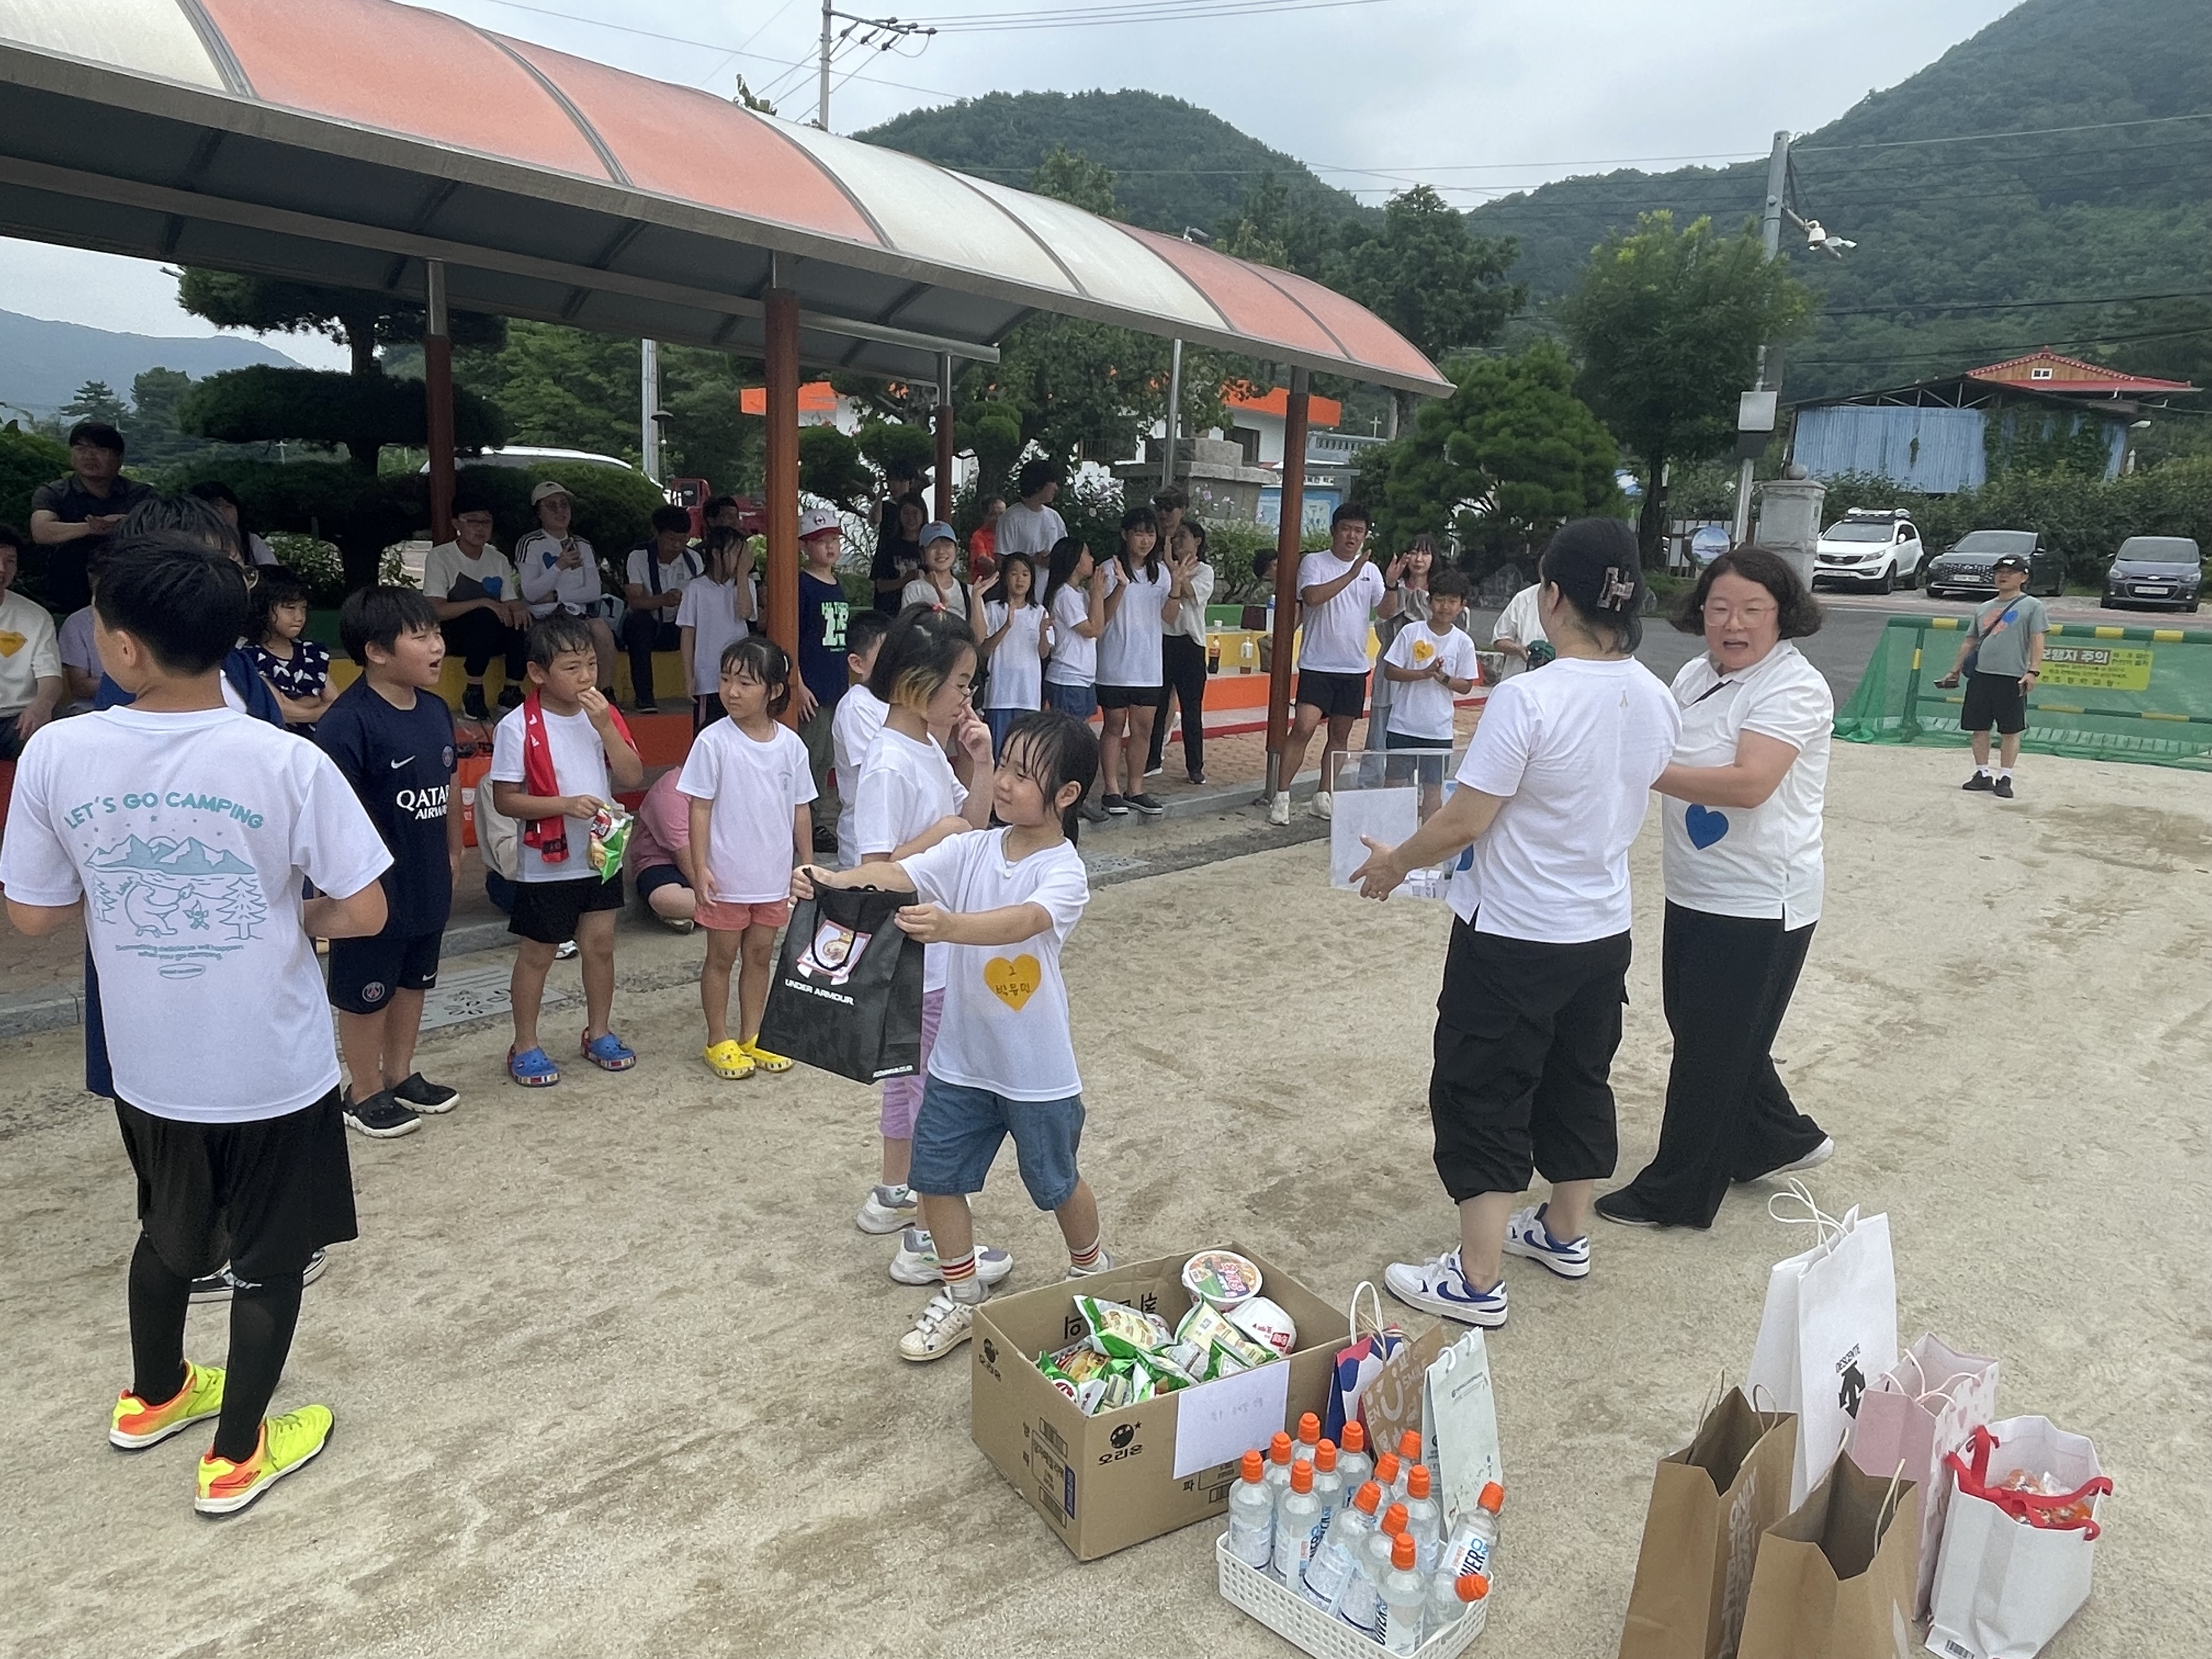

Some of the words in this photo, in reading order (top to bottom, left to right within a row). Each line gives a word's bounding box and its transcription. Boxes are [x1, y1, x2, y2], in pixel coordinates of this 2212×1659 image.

[2080, 650, 2109, 664] 주의
[64, 795, 116, 830] LET'S
[122, 792, 159, 810] GO
[166, 791, 264, 829] CAMPING
[785, 979, 813, 994] UNDER
[814, 988, 855, 1006] ARMOUR
[1836, 1343, 1860, 1373] DESCENTE
[1098, 1443, 1144, 1466] 오리온
